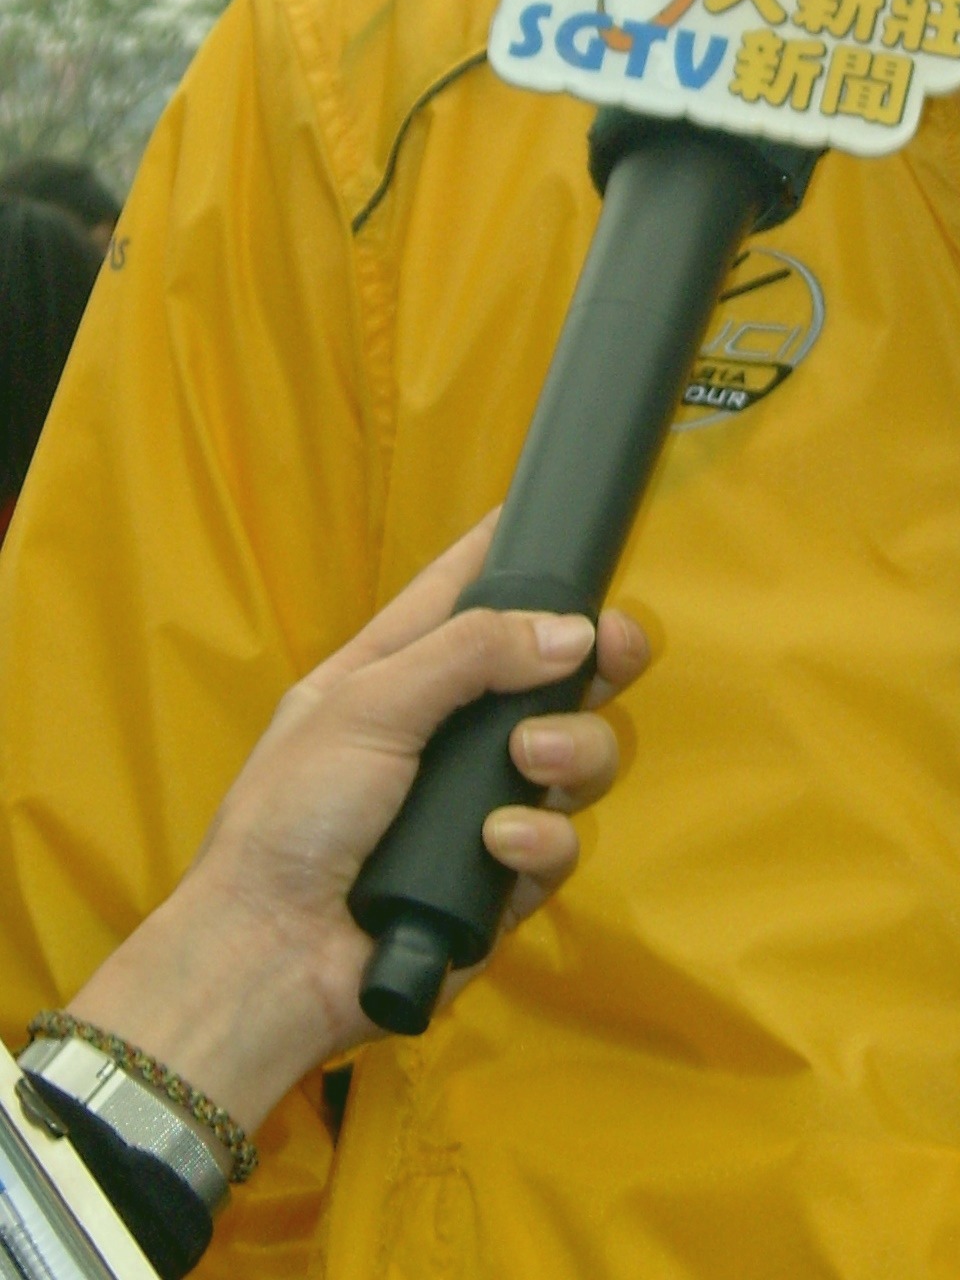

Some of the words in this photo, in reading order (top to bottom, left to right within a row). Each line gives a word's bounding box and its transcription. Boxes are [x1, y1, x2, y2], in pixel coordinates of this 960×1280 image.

[508, 2, 728, 91] SGTV
[728, 28, 916, 126] 新聞
[685, 384, 749, 410] OUR
